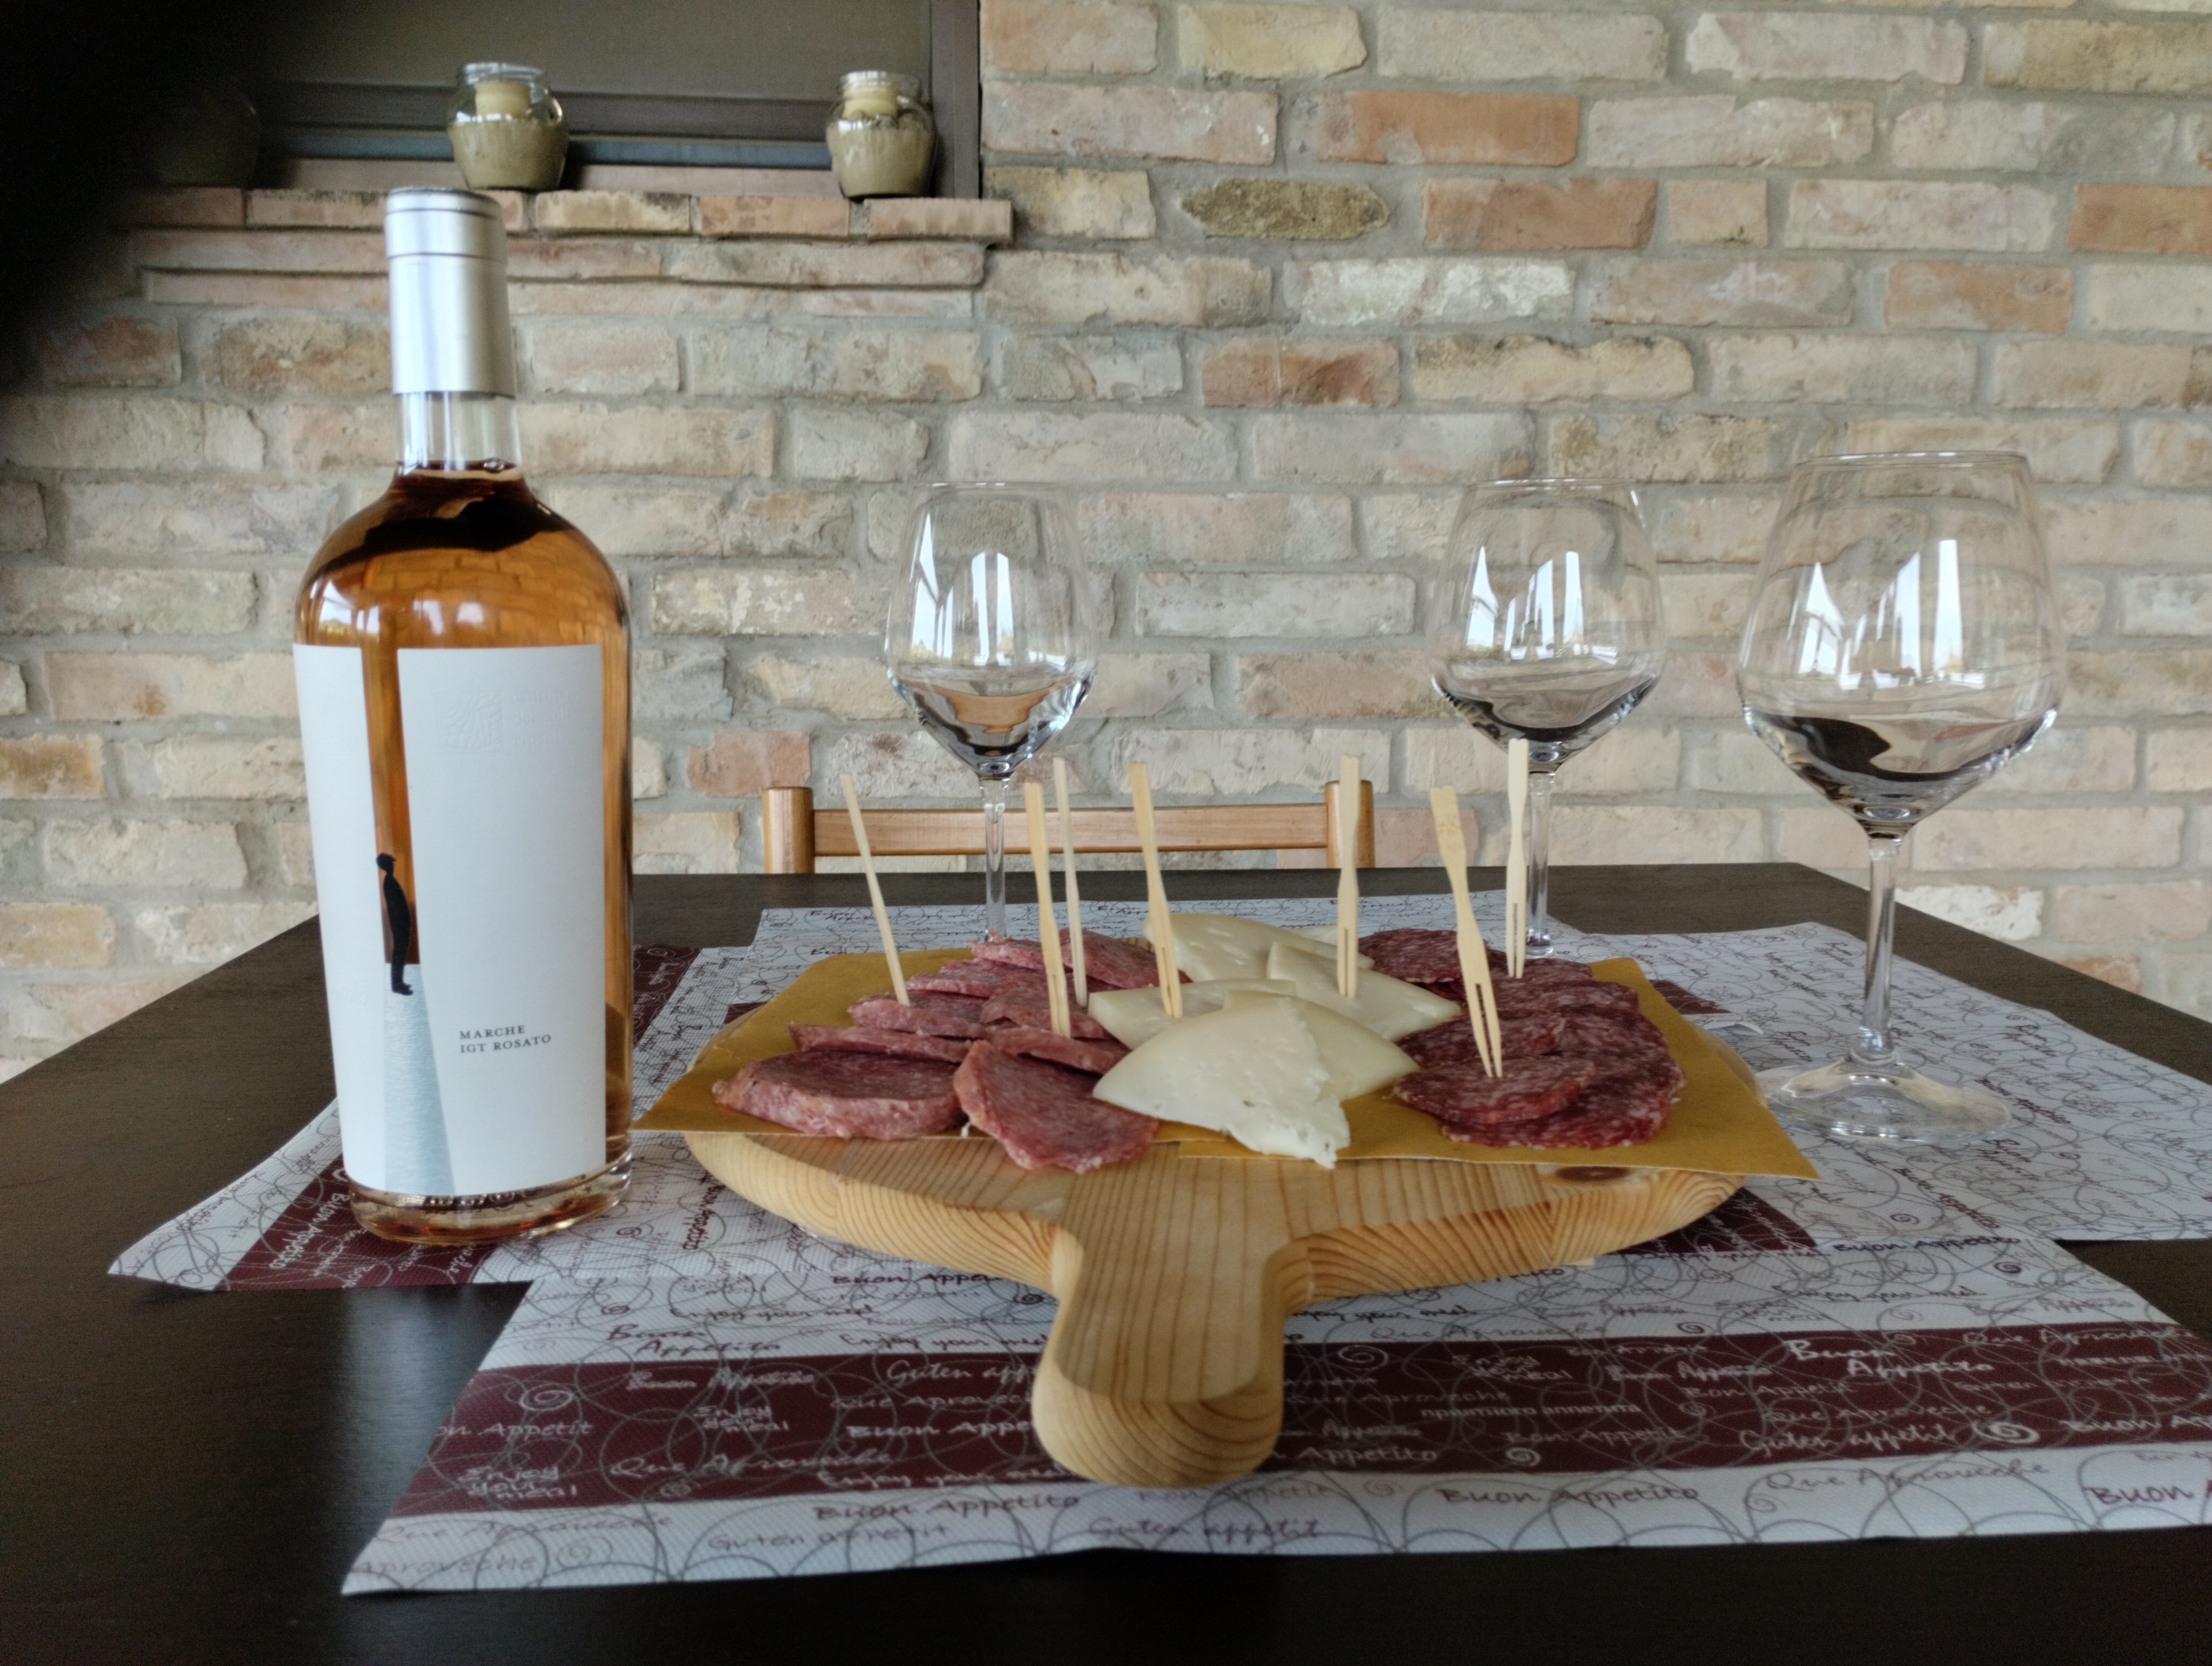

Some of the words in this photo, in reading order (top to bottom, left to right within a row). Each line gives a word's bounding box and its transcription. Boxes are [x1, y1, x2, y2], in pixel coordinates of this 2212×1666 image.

[460, 1025, 525, 1040] MARCHE
[461, 1043, 486, 1054] IGT
[493, 1034, 551, 1050] ROSATO
[886, 1359, 973, 1386] Guten
[479, 1422, 594, 1441] Appetit
[948, 1420, 1034, 1438] Appe
[815, 1504, 915, 1520] Buon
[925, 1490, 1079, 1519] Appetito
[1434, 1487, 1545, 1505] Buon
[1555, 1483, 1699, 1509] Appetito
[2082, 1486, 2194, 1505] Buon
